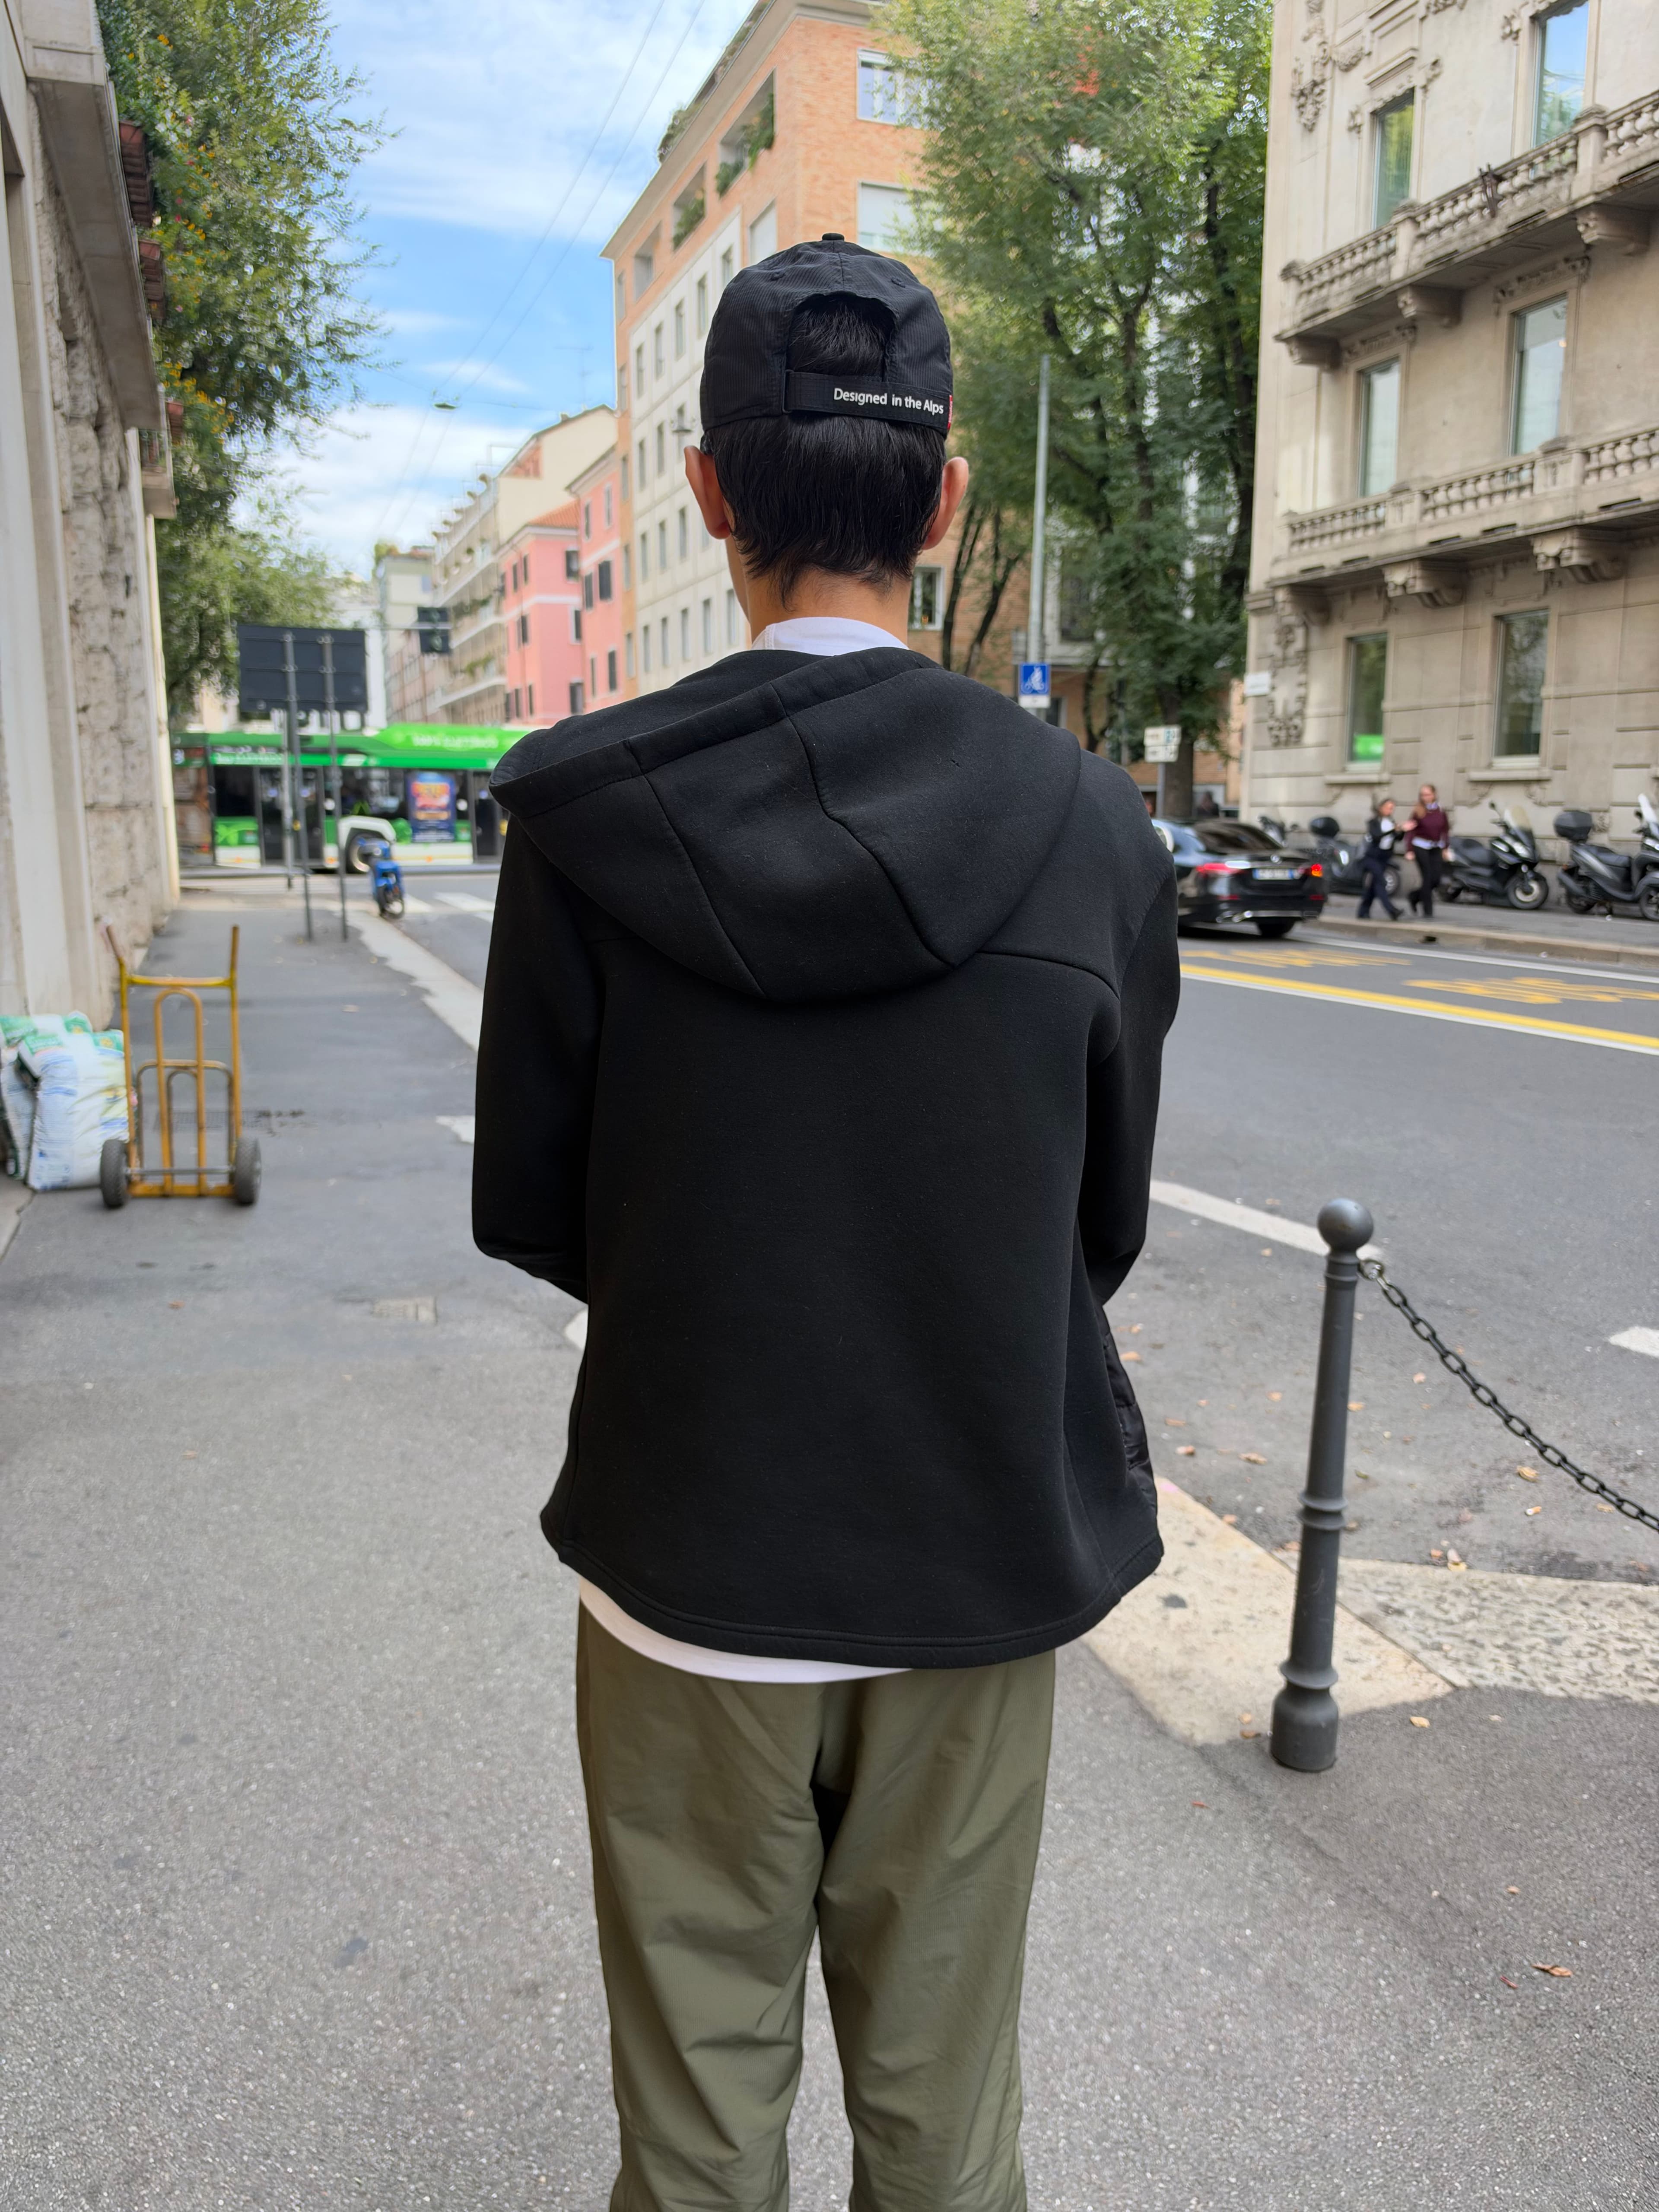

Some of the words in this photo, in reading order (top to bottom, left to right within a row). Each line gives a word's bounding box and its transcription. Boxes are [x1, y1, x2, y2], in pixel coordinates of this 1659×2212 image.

[833, 388, 887, 406] Designed
[891, 394, 902, 407] in
[904, 396, 922, 410] the
[923, 399, 944, 416] Alps
